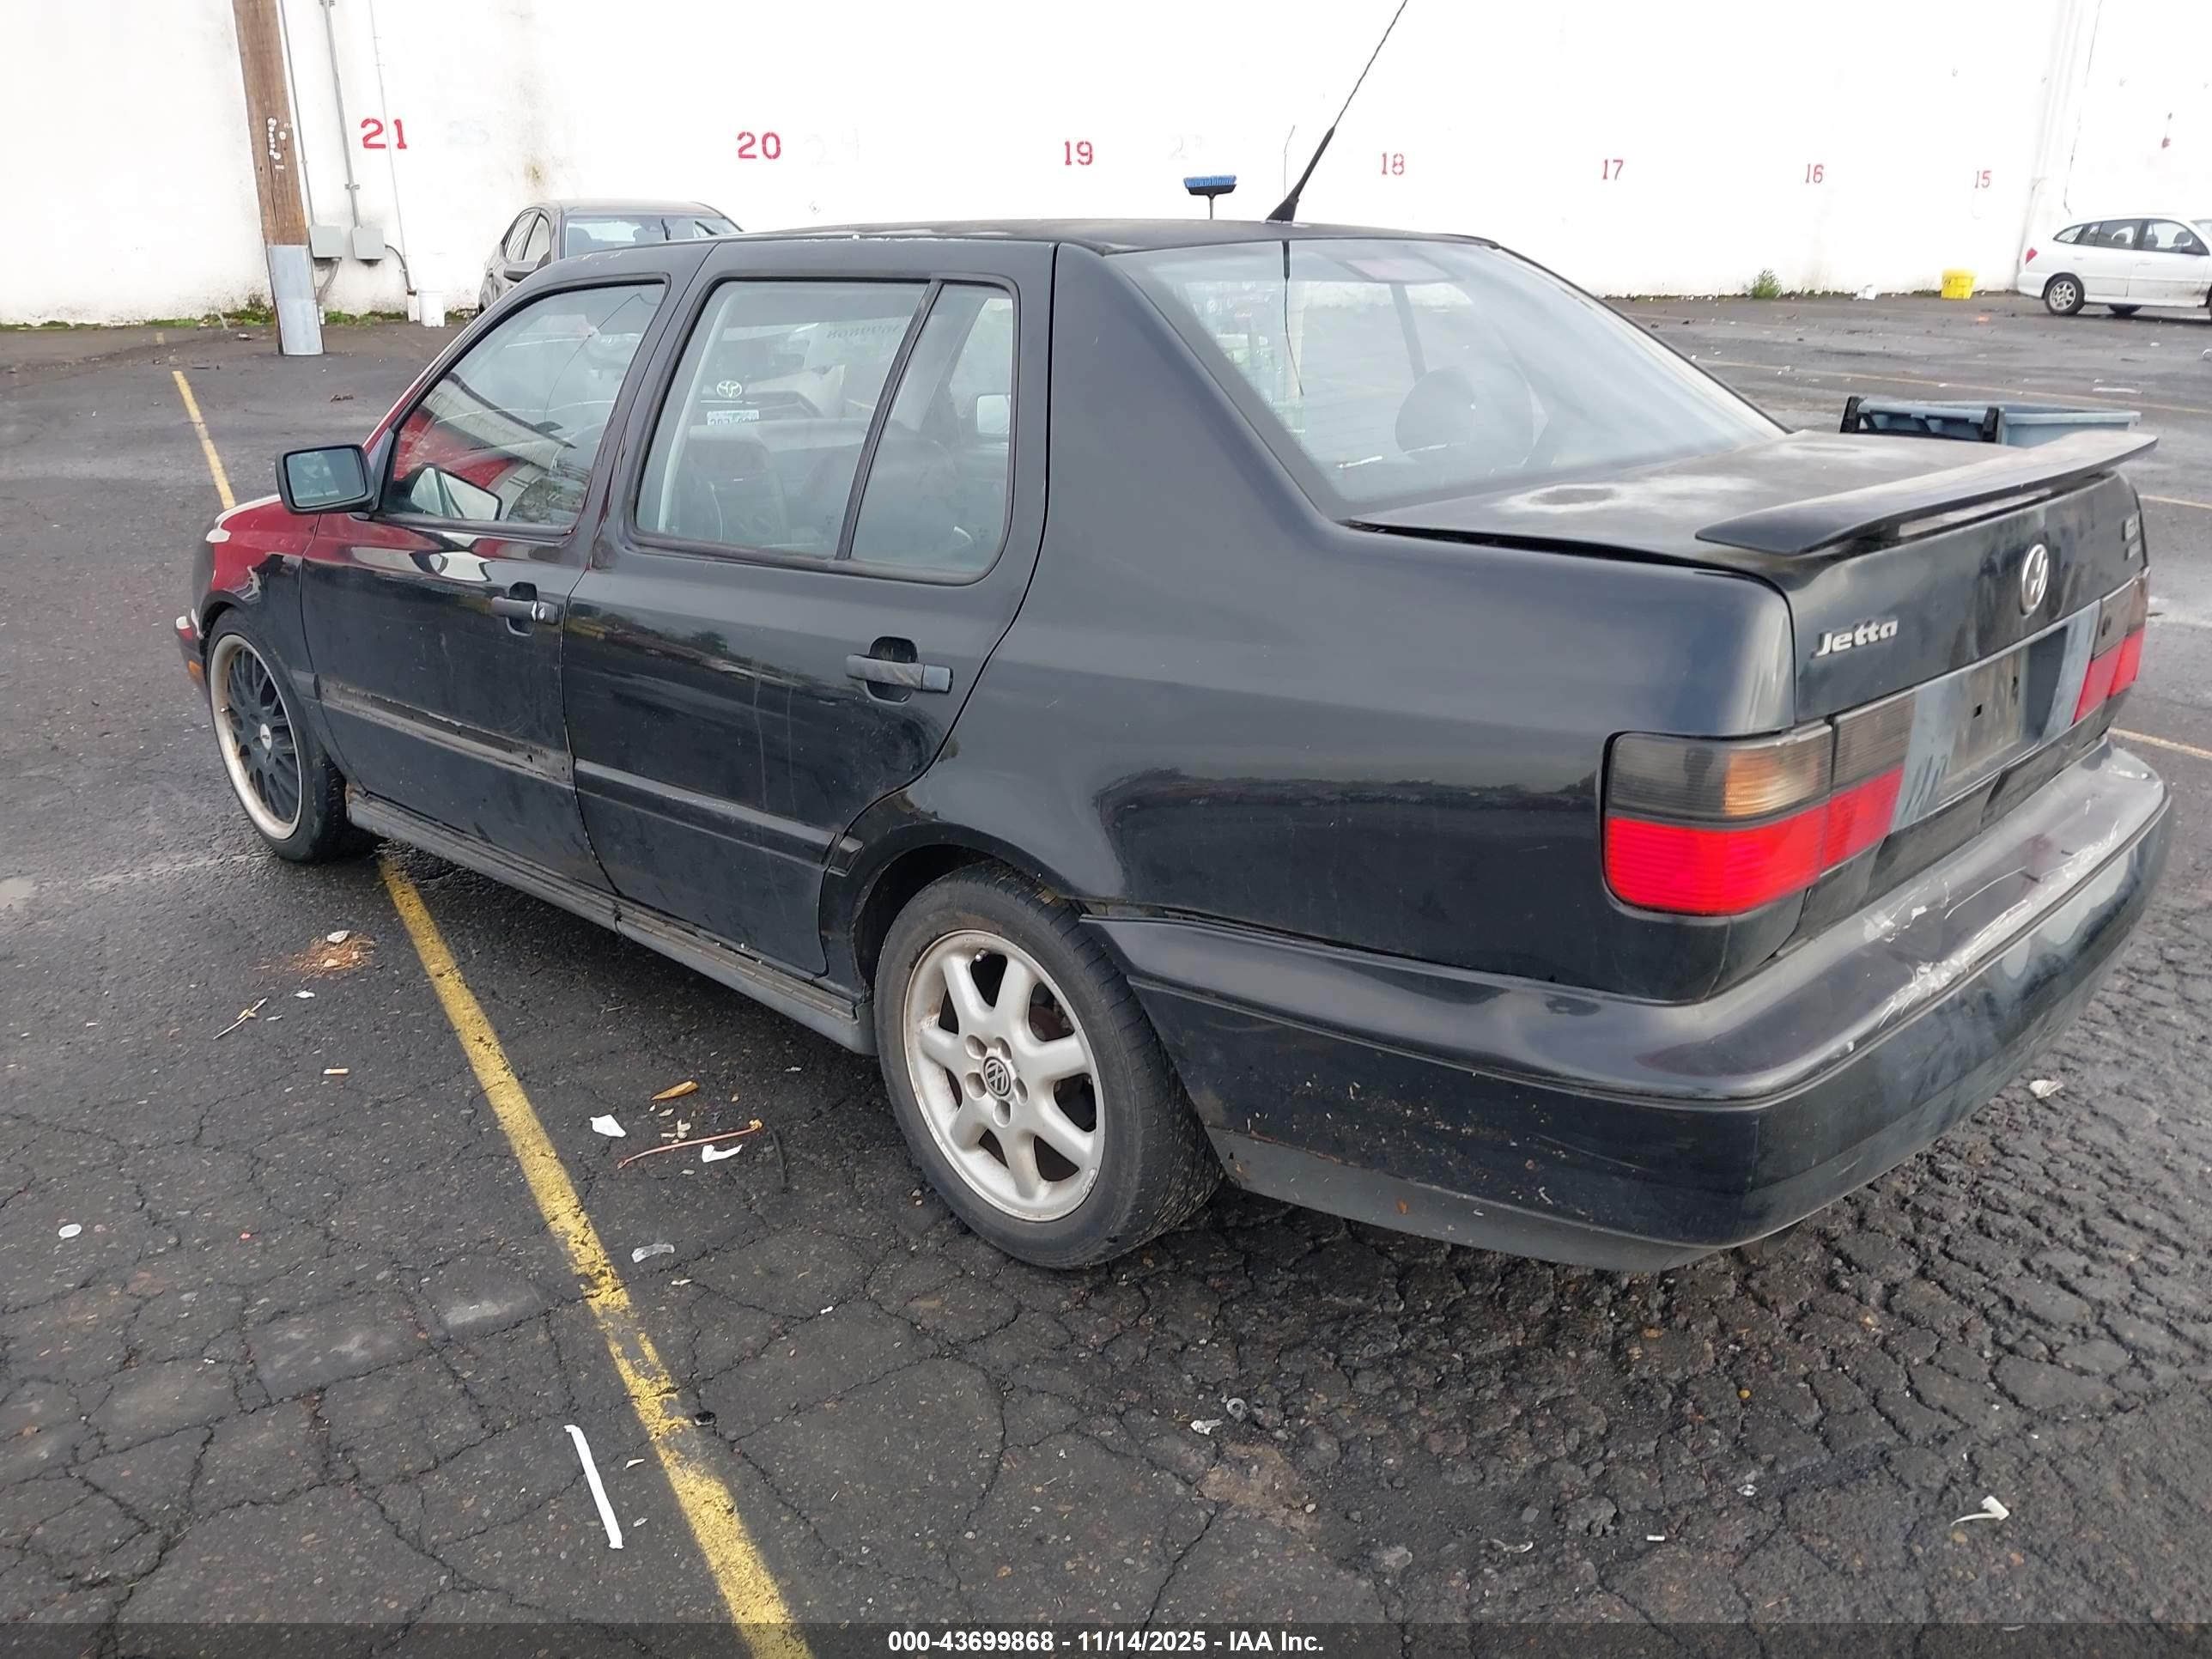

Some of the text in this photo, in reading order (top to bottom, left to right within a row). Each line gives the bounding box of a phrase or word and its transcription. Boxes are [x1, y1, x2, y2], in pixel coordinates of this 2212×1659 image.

[360, 118, 408, 149] 21
[737, 131, 781, 160] 20
[1064, 140, 1094, 167] 19
[1382, 153, 1405, 176] 18
[1602, 158, 1624, 180] 17
[1805, 163, 1824, 184] 16
[1974, 170, 1992, 189] 15
[1815, 619, 1899, 658] Jetta
